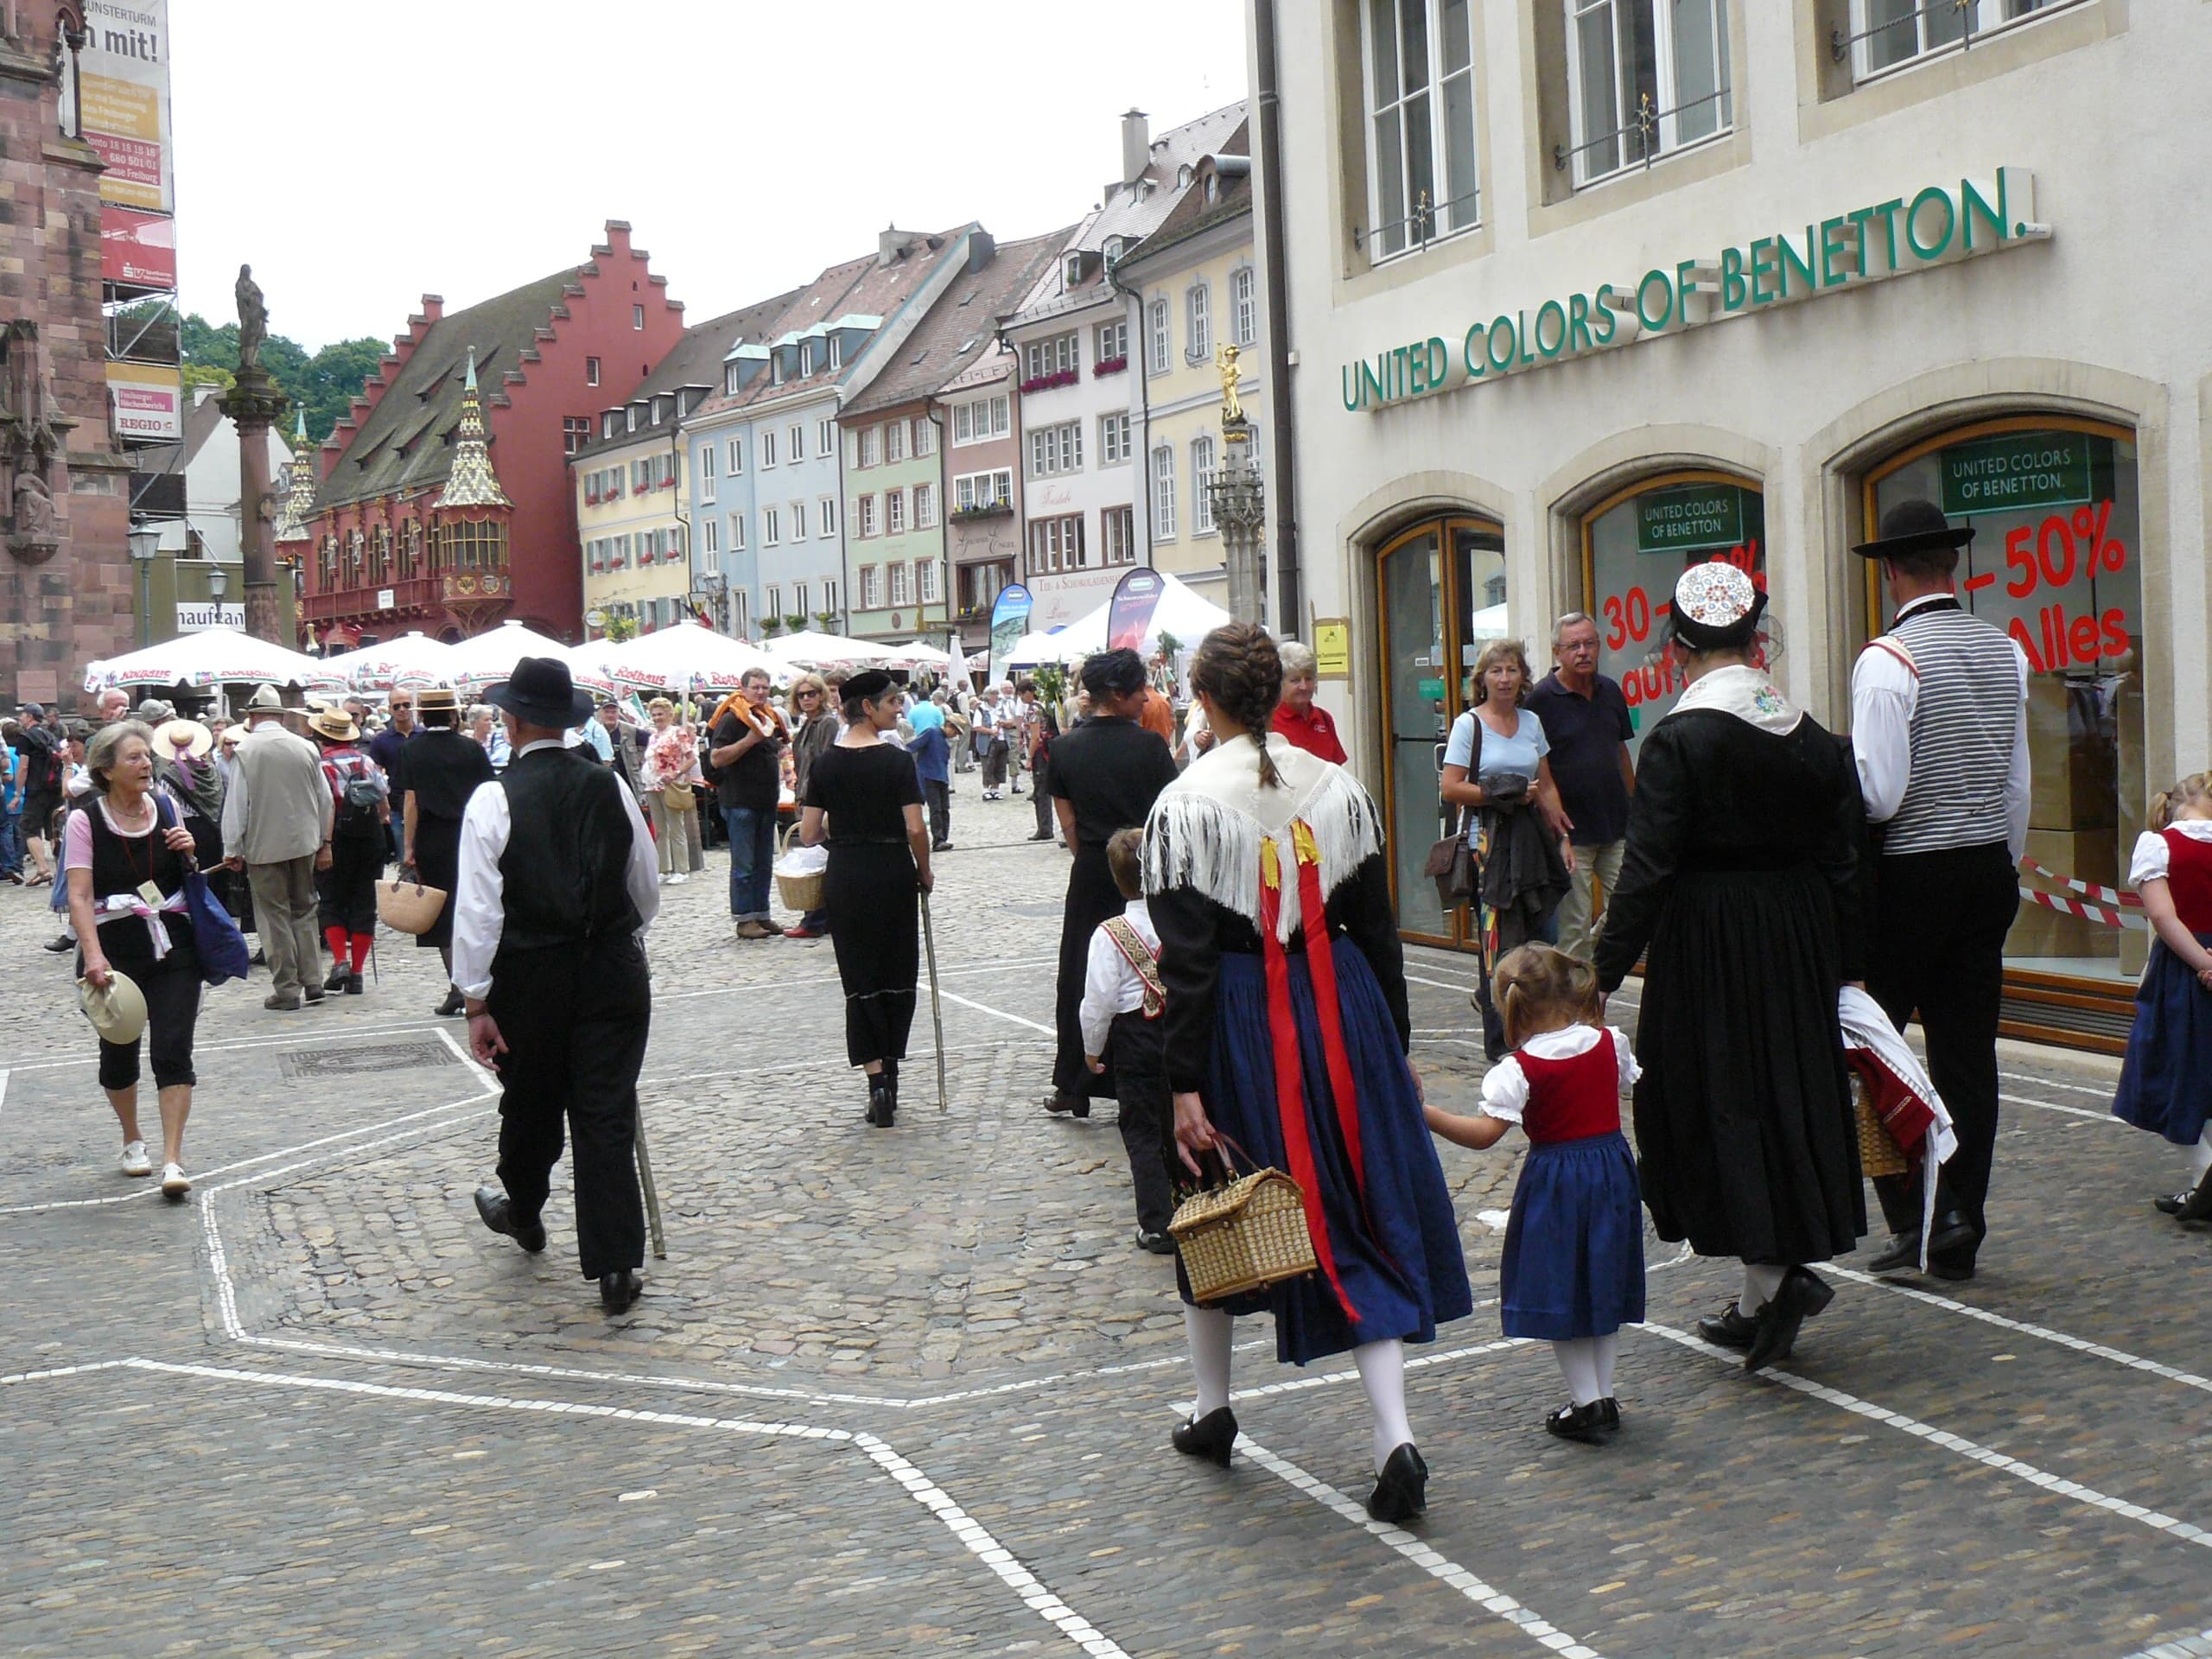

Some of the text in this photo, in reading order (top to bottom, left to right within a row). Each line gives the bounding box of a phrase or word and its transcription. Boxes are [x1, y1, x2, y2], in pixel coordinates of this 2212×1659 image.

[105, 29, 157, 62] mit!
[127, 168, 158, 184] Freiburg
[1342, 336, 1448, 412] UNITED
[1464, 283, 1617, 378] COLORS
[1637, 259, 1696, 332] OF
[119, 417, 162, 431] REGIO
[1953, 448, 2071, 477] UNITED COLORS
[1962, 480, 1981, 499] OF
[1645, 499, 1729, 522] UNITED COLORS
[1651, 525, 1666, 539] OF
[2008, 603, 2130, 674] Alles
